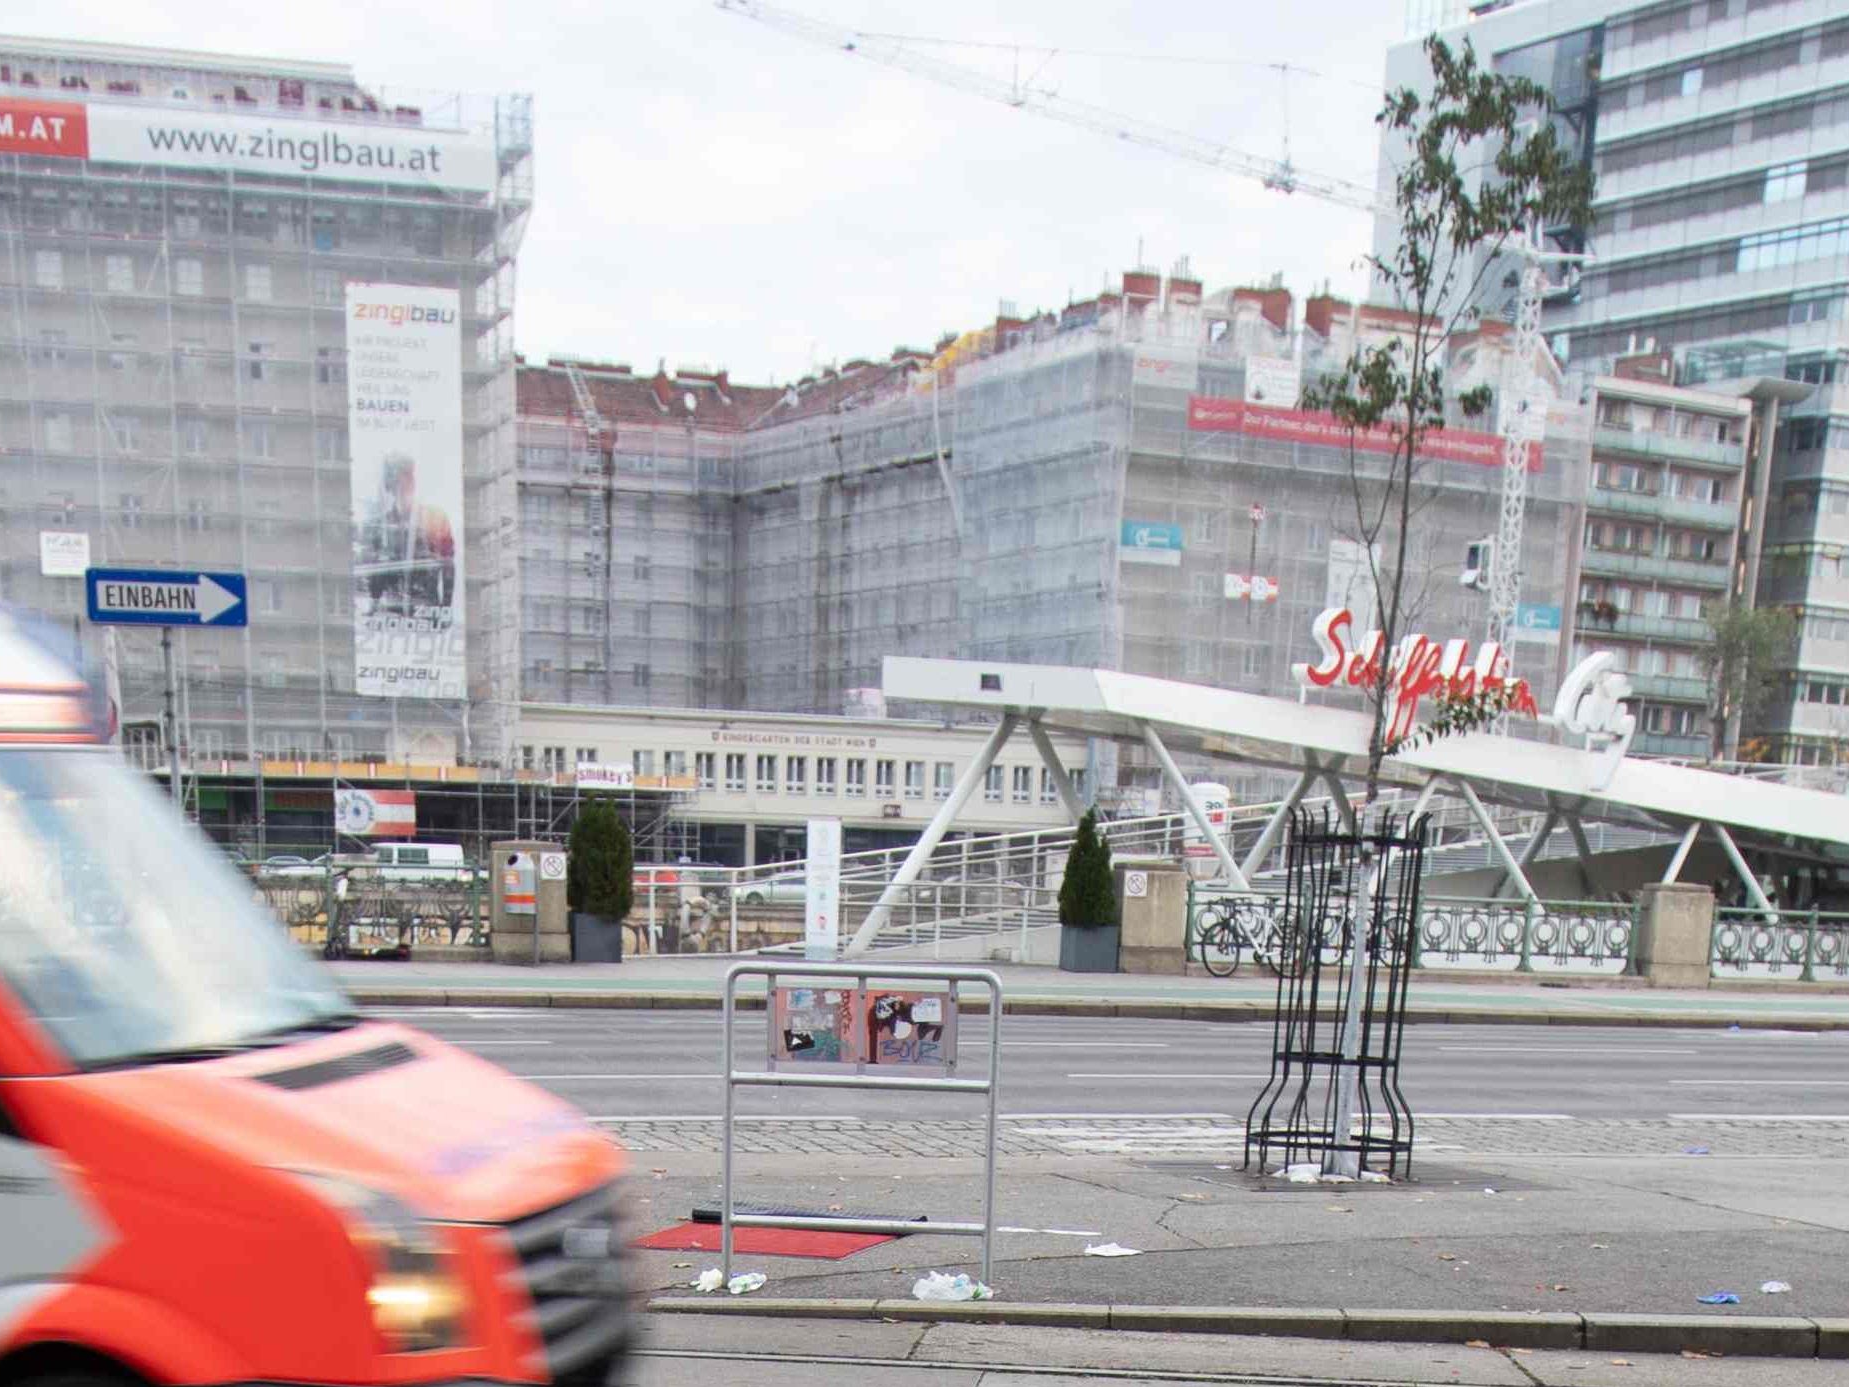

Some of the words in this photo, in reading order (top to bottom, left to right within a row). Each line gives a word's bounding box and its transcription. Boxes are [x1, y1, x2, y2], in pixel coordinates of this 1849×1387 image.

[148, 125, 443, 172] www.zinglbau.at
[356, 399, 410, 412] BAUEN
[105, 584, 197, 610] EINBAHN
[358, 665, 441, 684] zinglbau
